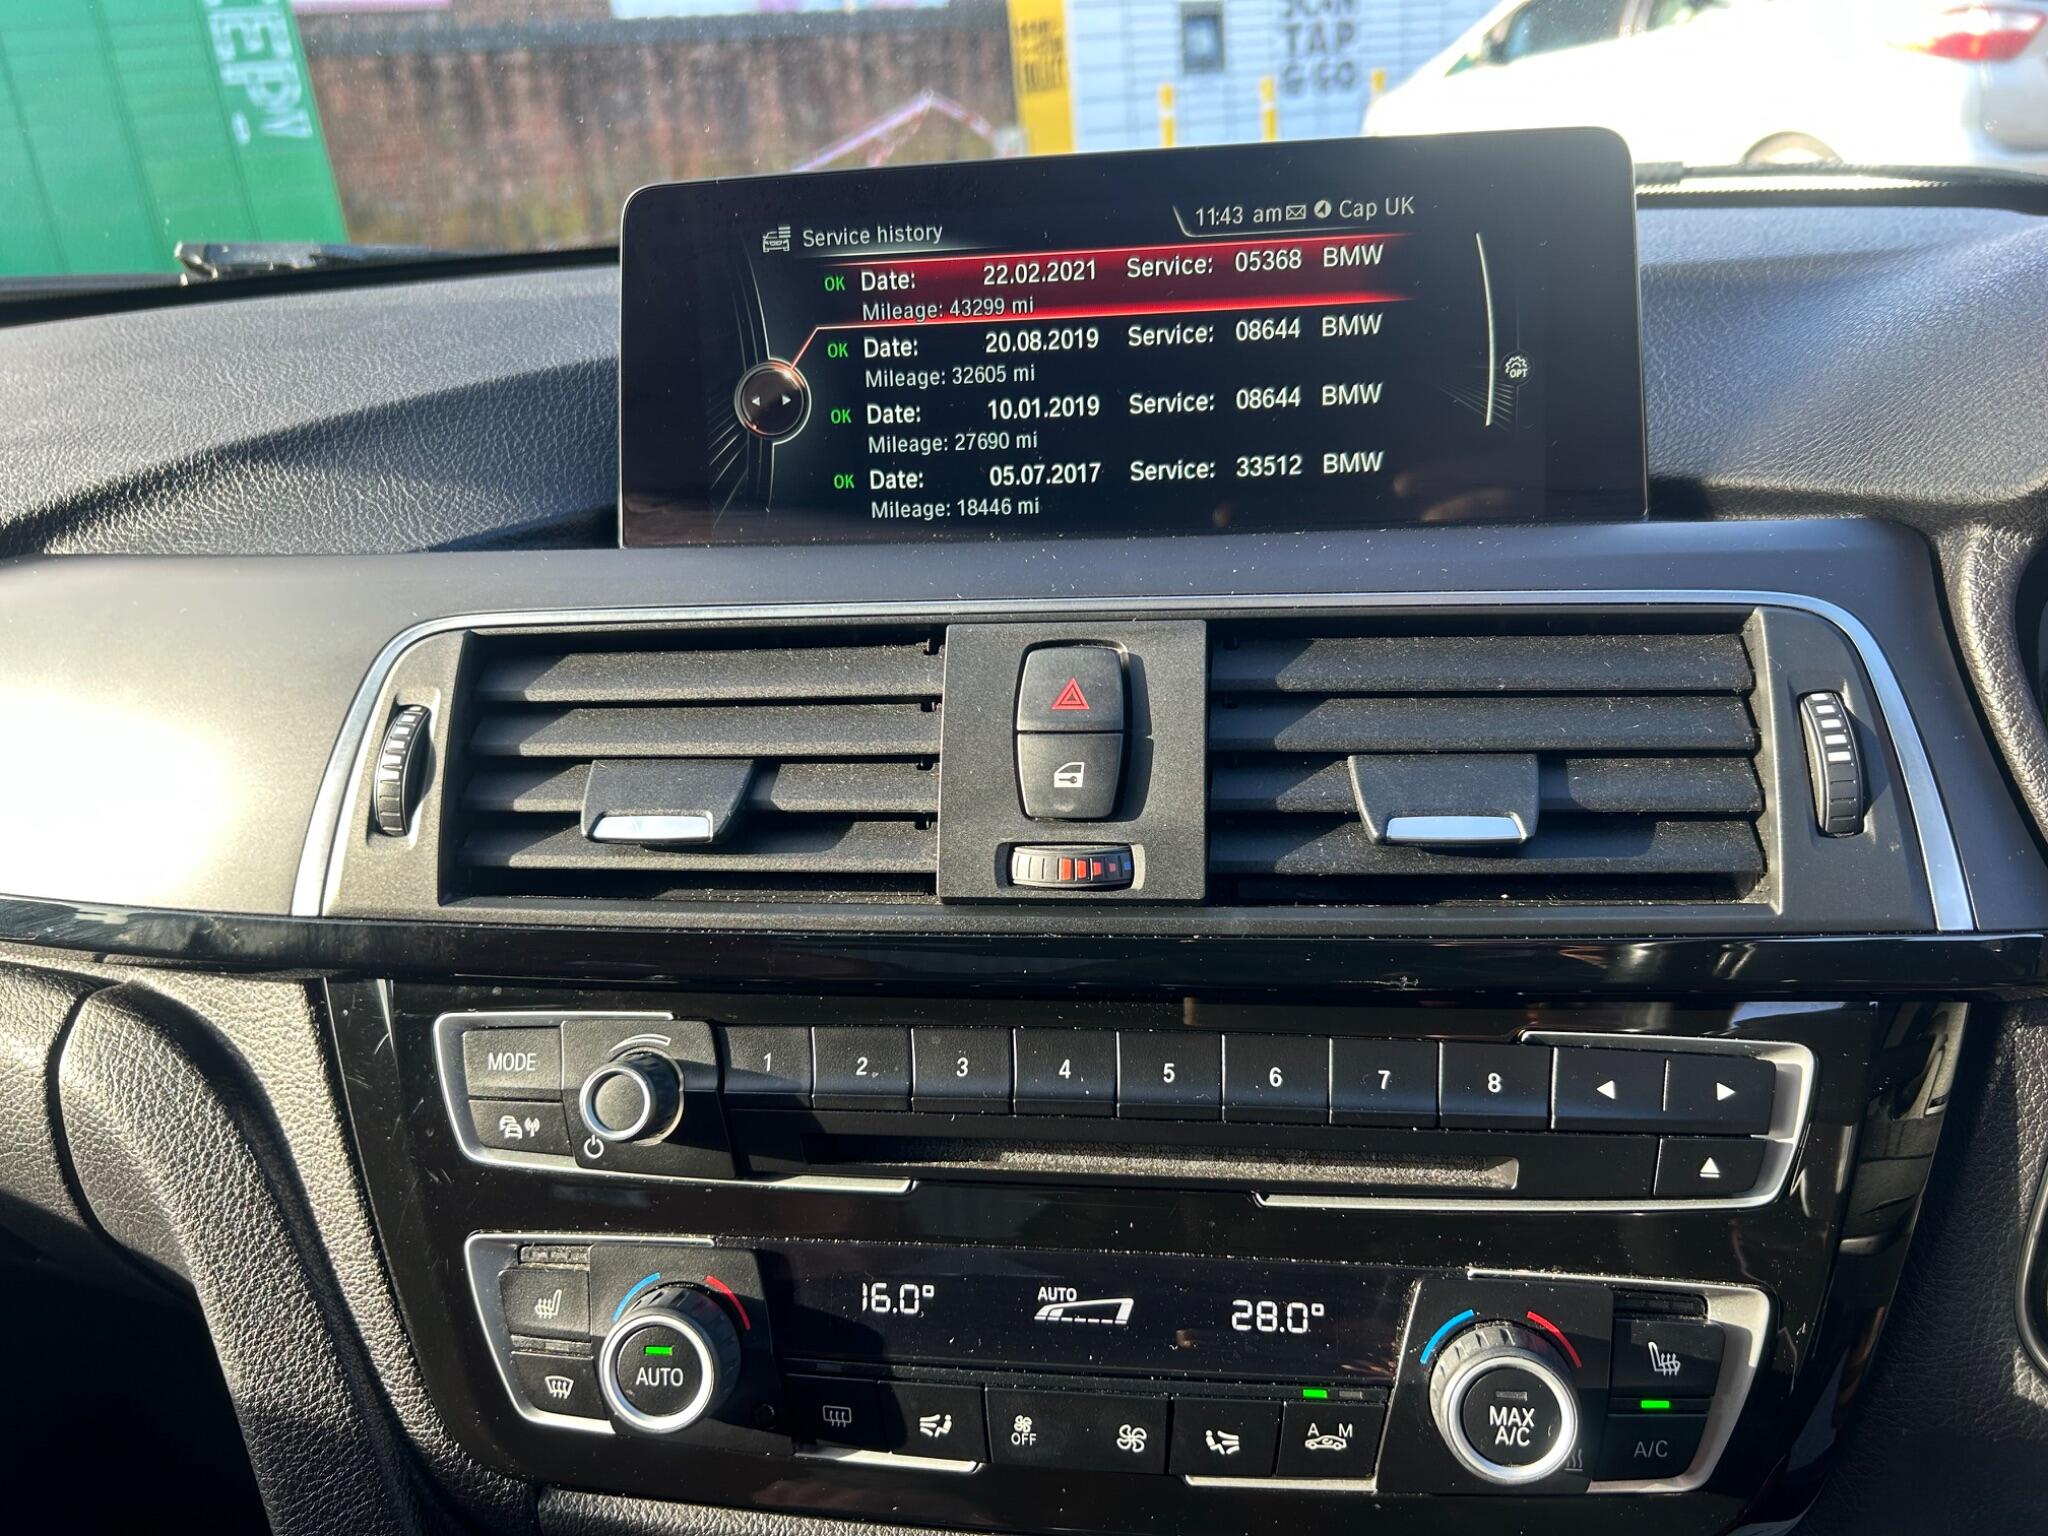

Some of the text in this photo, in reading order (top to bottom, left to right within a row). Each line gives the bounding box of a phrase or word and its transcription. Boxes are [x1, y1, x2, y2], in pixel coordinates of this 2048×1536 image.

[1280, 20, 1356, 57] TAP
[1195, 196, 1415, 227] 11:43 am Cap UK
[802, 224, 944, 248] Service history
[860, 243, 1384, 293] Date: 22.02.2021 Service: 05368 BMW
[824, 274, 846, 293] OK
[861, 296, 1034, 324] Mileage: 43299 mi
[863, 312, 1383, 359] Date: 20.08.2019 Service: 08644 BMW
[827, 342, 849, 359] OK
[864, 364, 1036, 390] Mileage: 32605 mi
[1509, 367, 1529, 379] OPT
[866, 381, 1384, 425] Date: 10.01.2019 Service: 08644 BMW
[830, 408, 852, 425] OK
[867, 430, 1039, 456] Mileage: 27690 mi
[833, 473, 855, 490] OK
[869, 450, 1385, 491] Date: 05.07.2017 Service: 33512 BMW
[870, 497, 1041, 521] Mileage: 18446 mi
[487, 1052, 538, 1072] MODE
[763, 1053, 773, 1073] 1
[855, 1056, 868, 1076] 2
[955, 1057, 969, 1078] 3
[1057, 1058, 1072, 1079] 4
[1162, 1062, 1176, 1084] 5
[1268, 1066, 1284, 1088] 6
[1377, 1069, 1392, 1090] 7
[1486, 1072, 1502, 1094] 8
[1036, 1286, 1079, 1303] AUTO
[634, 1366, 685, 1388] AUTO
[1488, 1405, 1536, 1428] MAX
[1010, 1431, 1037, 1447] OFF
[1306, 1422, 1354, 1439] A M
[1494, 1426, 1531, 1448] A/C
[1633, 1439, 1669, 1459] A/C
